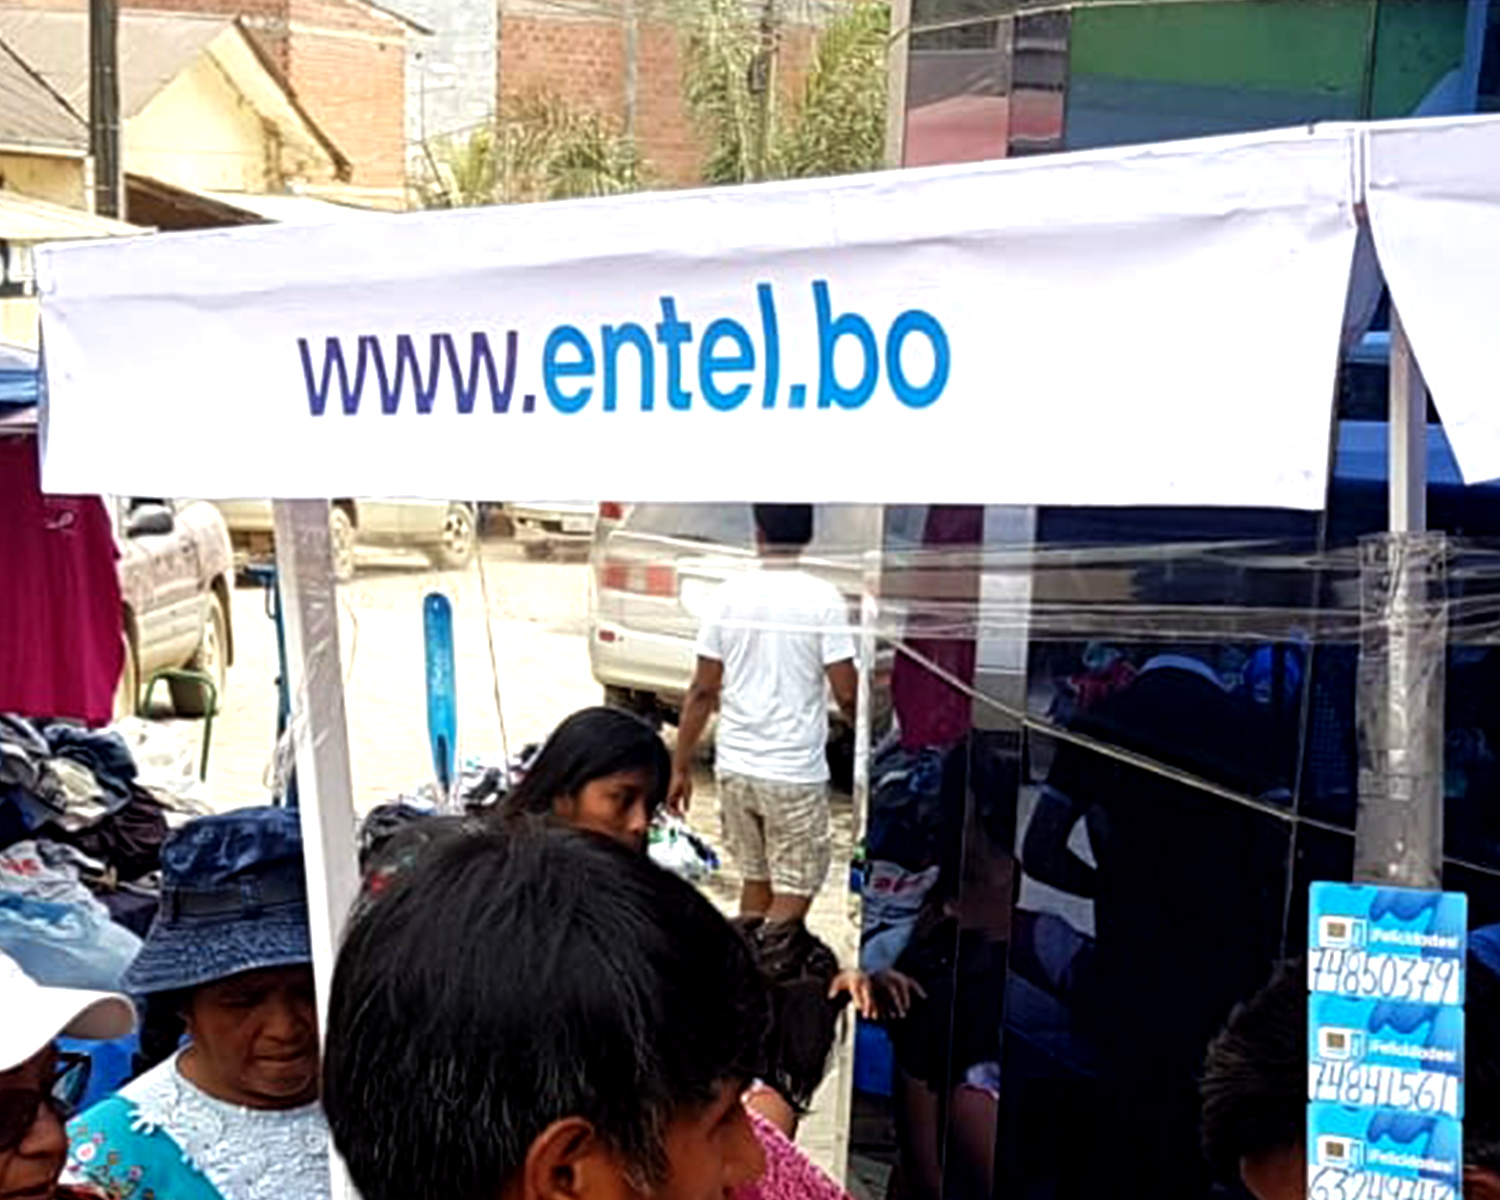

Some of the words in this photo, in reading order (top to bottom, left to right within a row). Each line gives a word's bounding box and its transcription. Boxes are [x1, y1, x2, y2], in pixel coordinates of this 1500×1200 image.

[298, 279, 952, 416] www.entel.bo
[1311, 948, 1455, 1005] 74850379
[1310, 1060, 1451, 1115] 74841561
